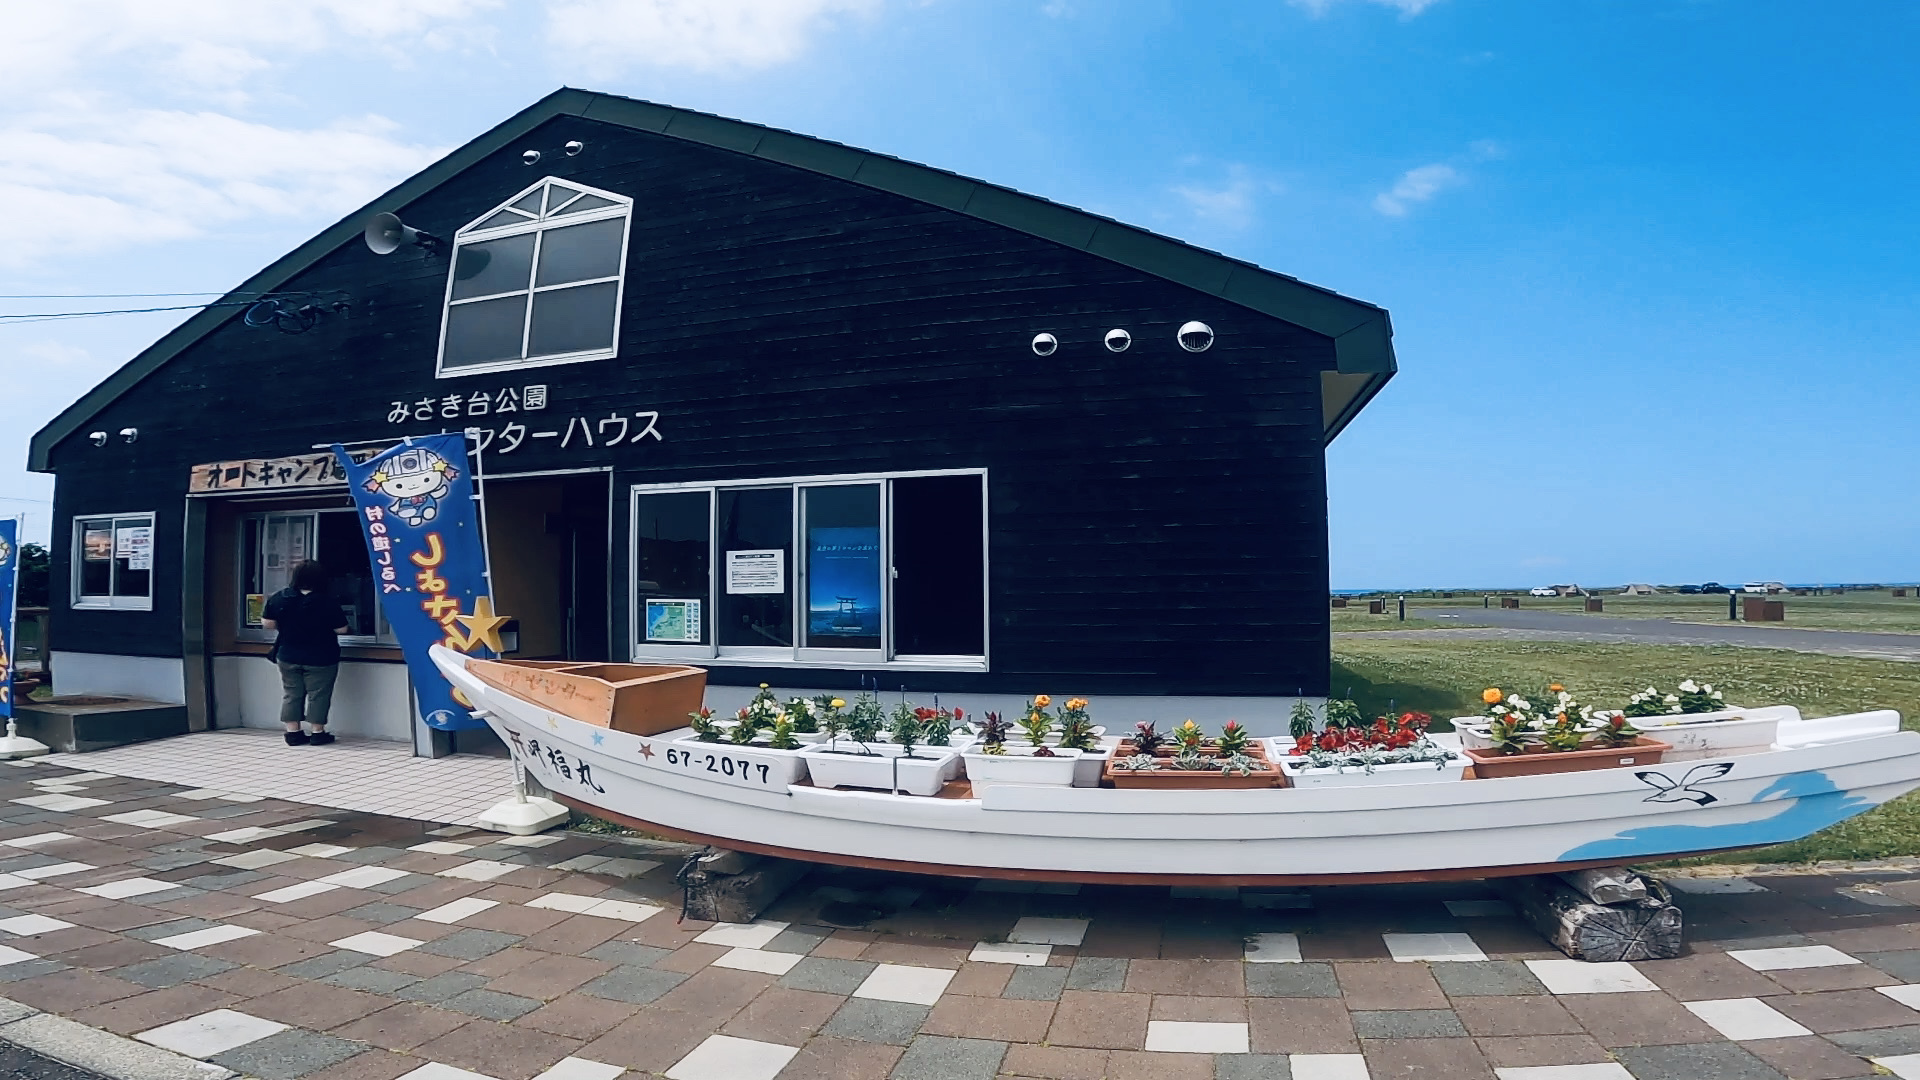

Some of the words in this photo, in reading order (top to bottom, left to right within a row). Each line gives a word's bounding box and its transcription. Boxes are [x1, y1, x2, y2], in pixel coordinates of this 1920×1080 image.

[387, 384, 547, 423] みさき台公園
[667, 748, 769, 784] 67-2077
